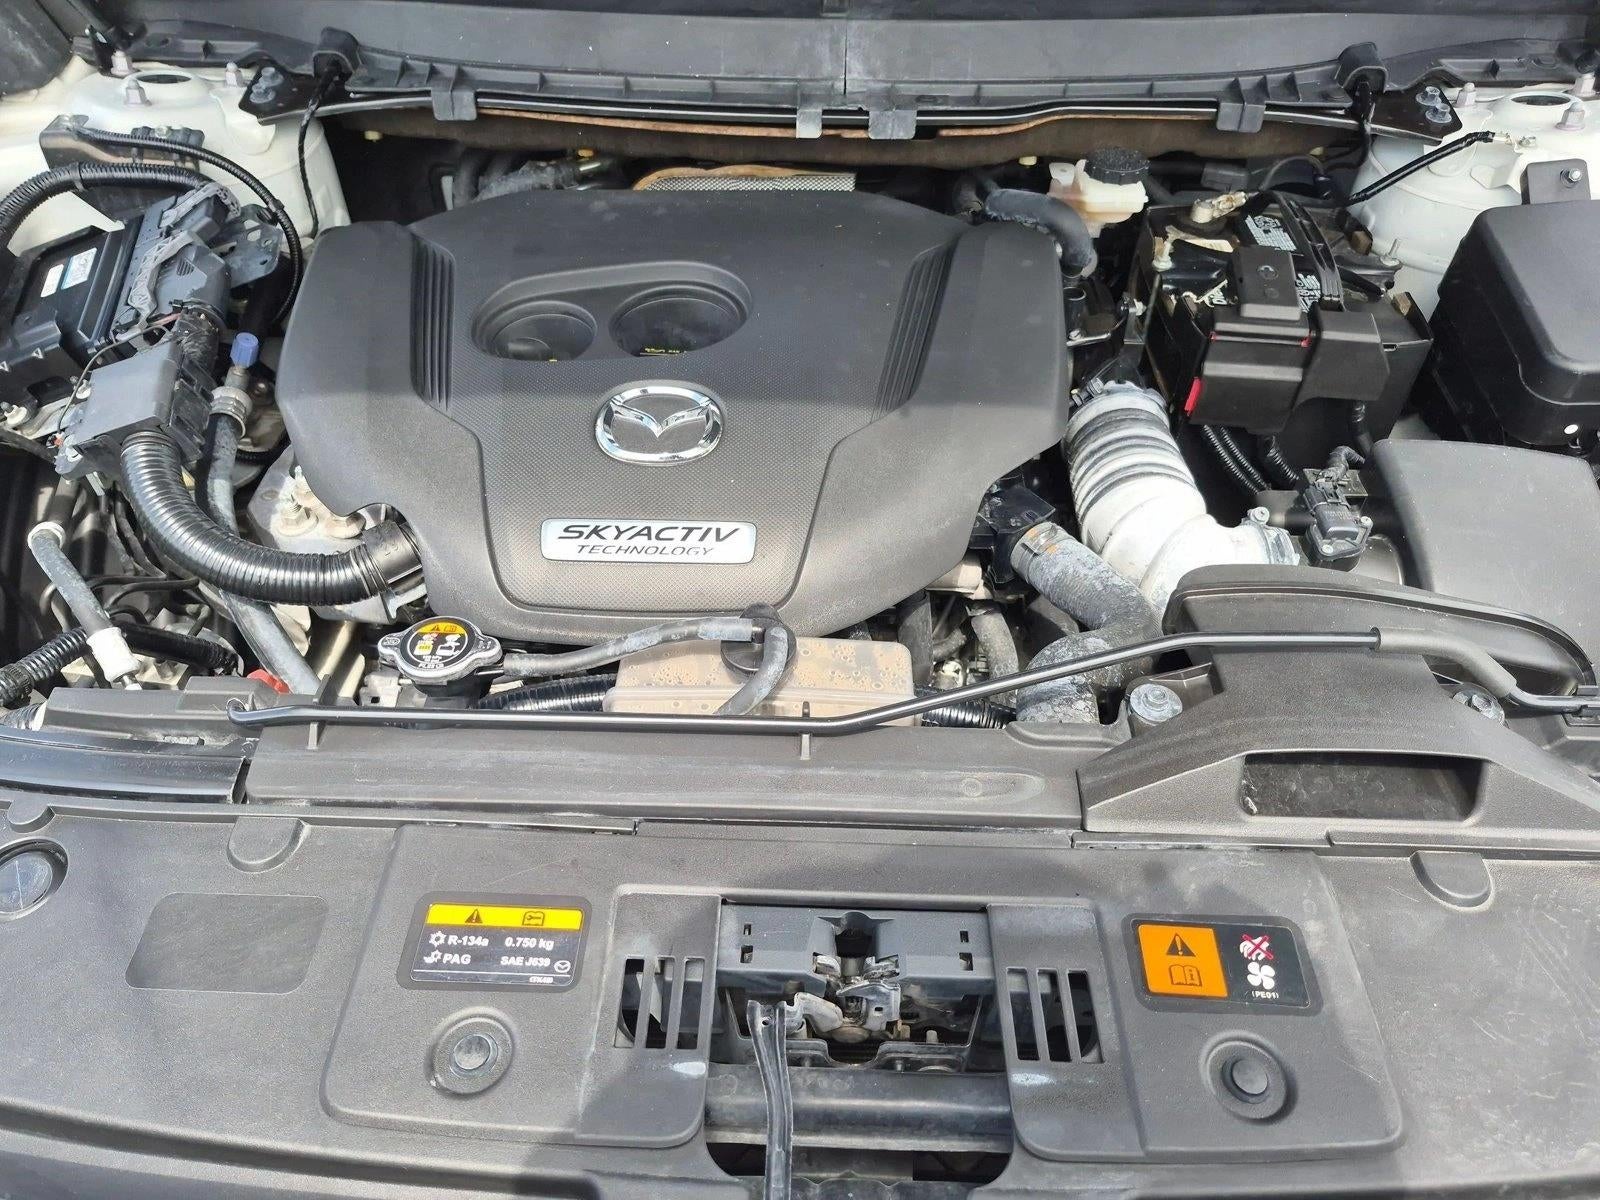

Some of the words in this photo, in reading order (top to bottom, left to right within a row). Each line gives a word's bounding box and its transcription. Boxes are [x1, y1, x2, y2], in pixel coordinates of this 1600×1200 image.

[558, 524, 740, 542] SKYACTIV
[576, 544, 715, 556] TECHNOLOGY
[447, 935, 490, 947] R-134a
[504, 936, 536, 948] 0.750
[538, 937, 555, 951] kg
[443, 953, 472, 965] PAG
[500, 955, 524, 965] SAE
